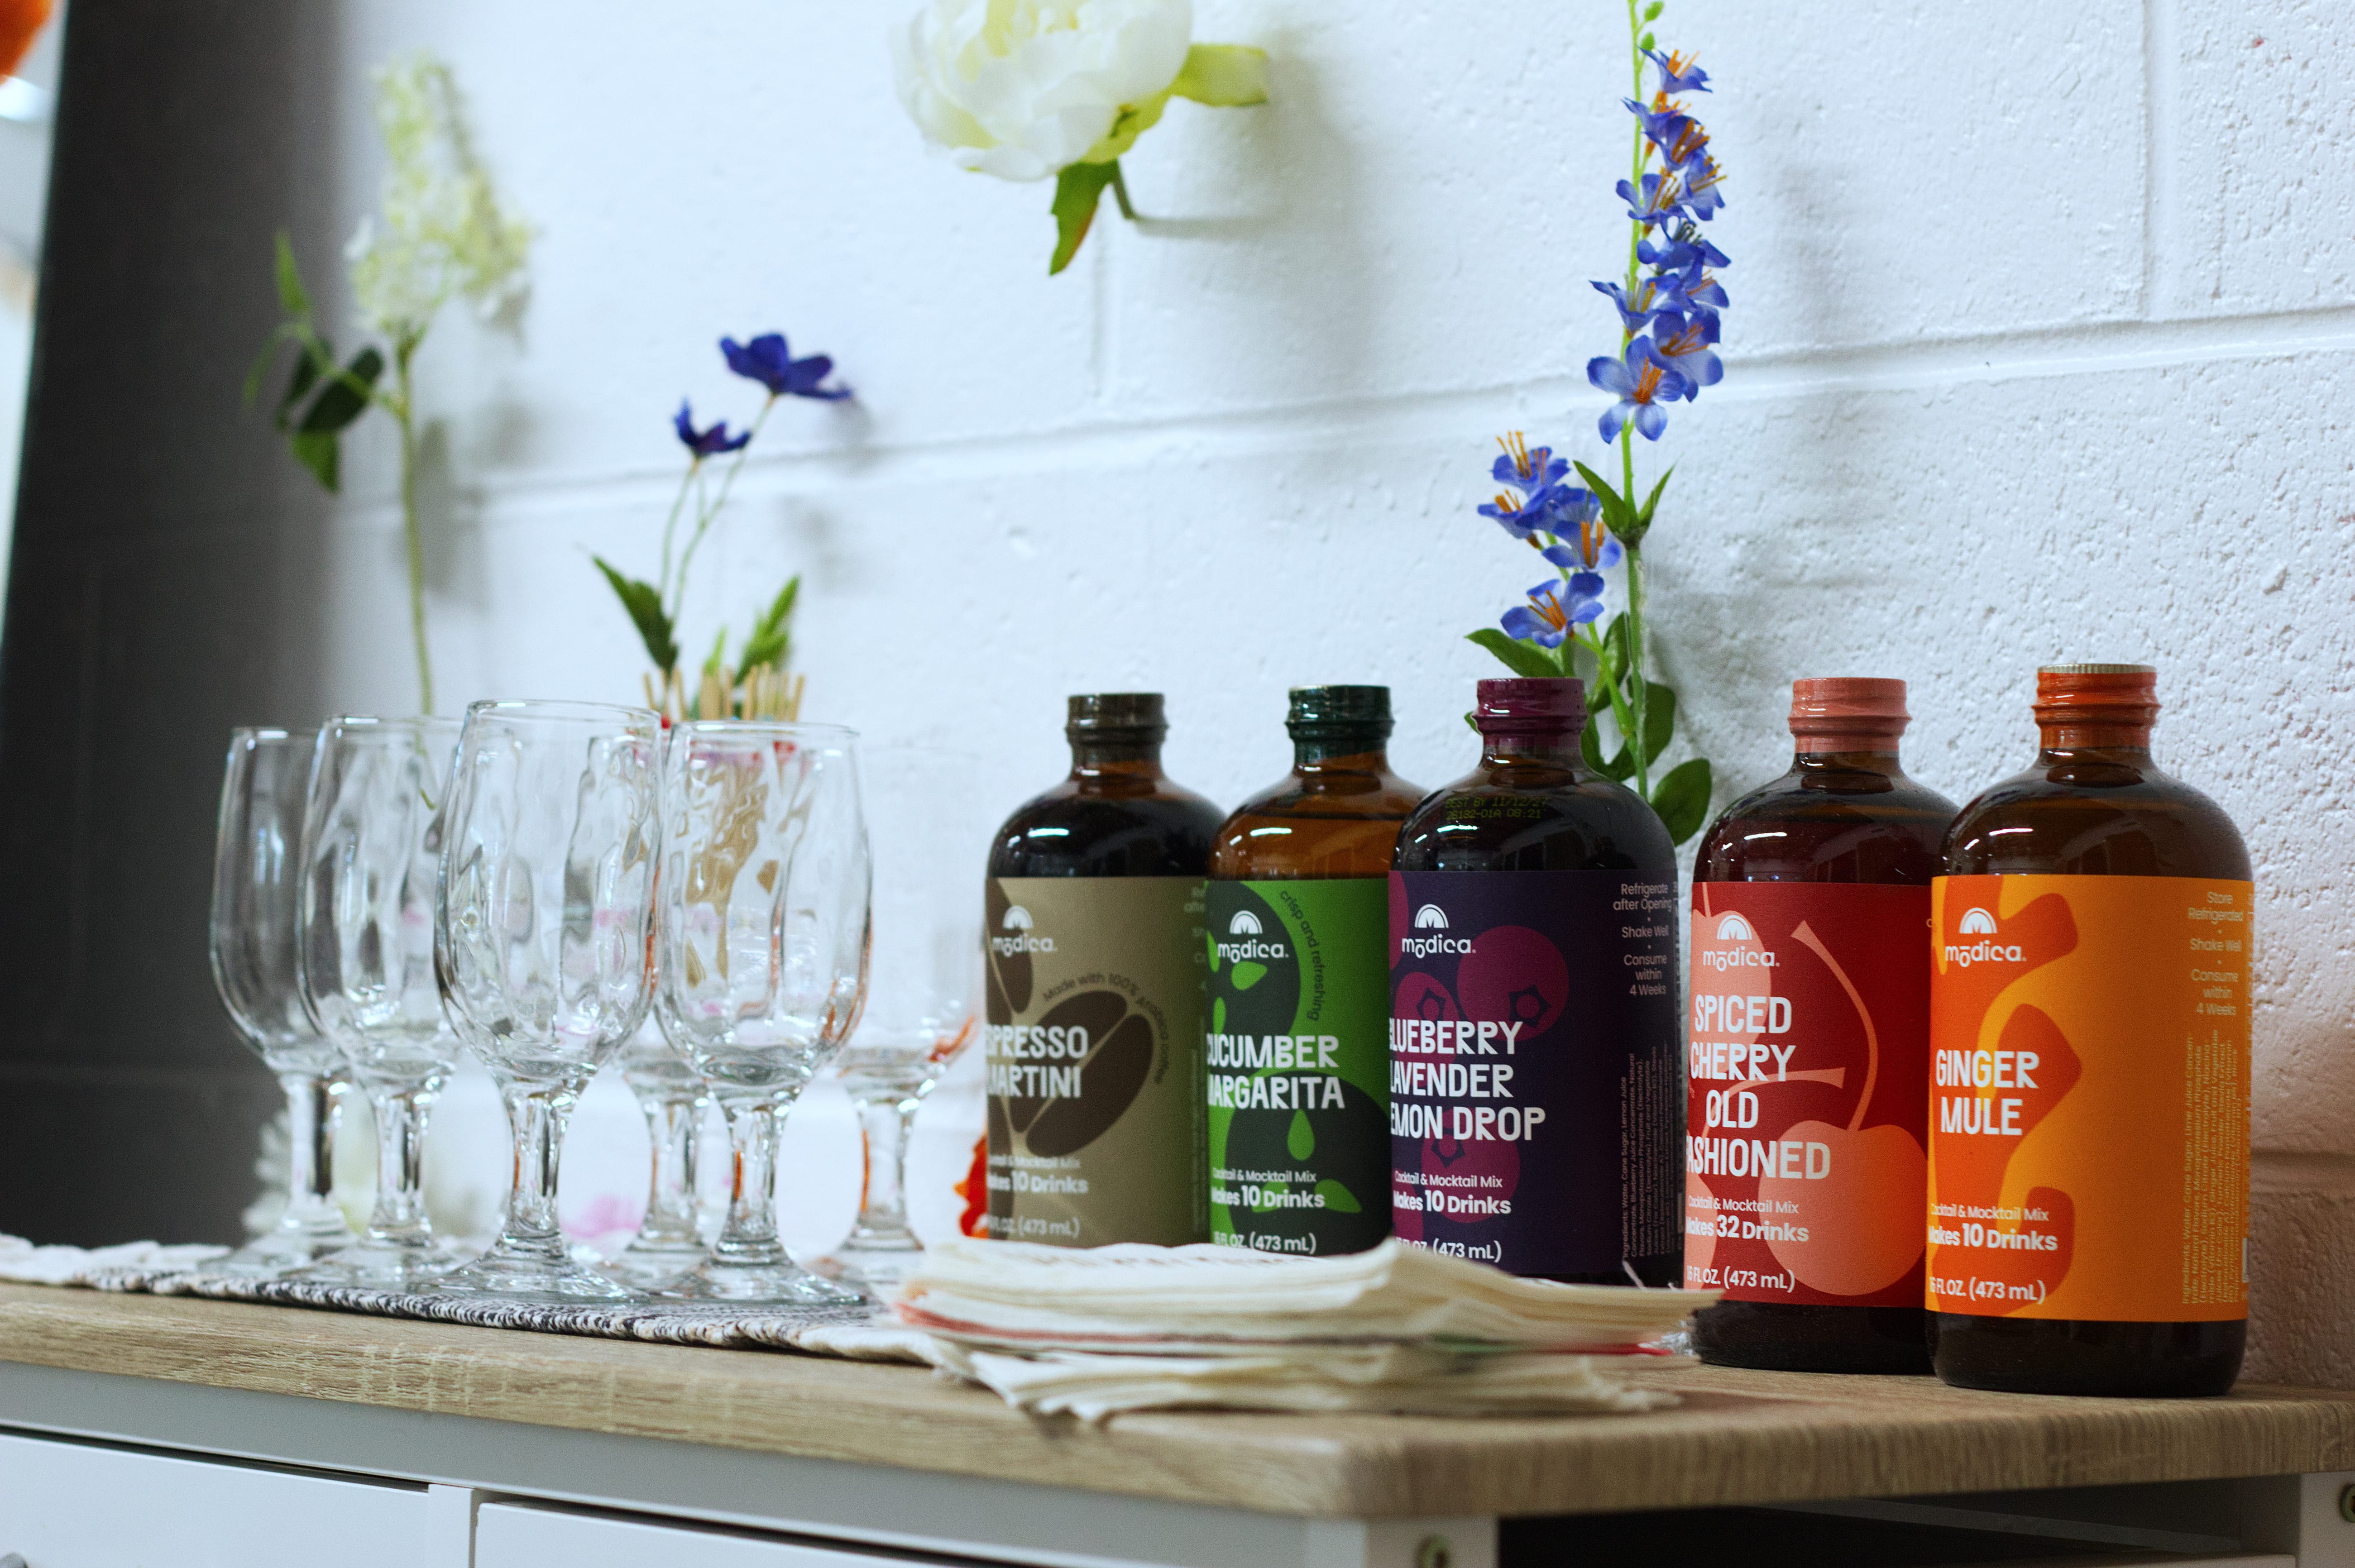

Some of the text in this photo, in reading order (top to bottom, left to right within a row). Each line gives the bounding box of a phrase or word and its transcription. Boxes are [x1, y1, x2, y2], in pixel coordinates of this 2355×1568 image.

[1621, 883, 1668, 898] Refrigerate
[2207, 891, 2233, 904] Store
[1613, 897, 1671, 913] after Opening
[1622, 925, 1670, 937] Shake Well
[1280, 890, 1326, 1021] crisp and refreshing
[2190, 938, 2224, 951] Shake
[1623, 954, 1667, 965] Consume
[1636, 968, 1662, 980] within
[2192, 969, 2238, 982] Consume
[1630, 984, 1666, 996] 4 Weeks
[2203, 985, 2232, 999] within
[1694, 994, 1792, 1033] SPICED
[2197, 1002, 2236, 1015] 4 Weeks
[1690, 1041, 1796, 1082] CHERRY
[1936, 1049, 2039, 1089] GINGER
[1706, 1090, 1759, 1128] OLD
[1941, 1096, 2023, 1135] MULE
[1453, 1106, 1546, 1141] DROP
[1011, 1171, 1028, 1192] 10
[1030, 1175, 1089, 1194] Drinks
[1237, 1170, 1245, 1181] &
[1246, 1171, 1292, 1182] Mocktail
[1295, 1171, 1316, 1182] Mix
[1420, 1173, 1428, 1186] &
[1429, 1174, 1477, 1187] Mocktail
[1480, 1176, 1503, 1188] Mix
[1241, 1185, 1261, 1207] 10
[1264, 1189, 1325, 1207] Drinks
[1393, 1190, 1512, 1214] Makes 10 Drinks
[1714, 1198, 1721, 1209] &
[1723, 1199, 1772, 1213] Mocktail
[1776, 1201, 1799, 1214] Mix
[1958, 1205, 1966, 1218] &
[1967, 1205, 2021, 1220] Mocktail
[2024, 1208, 2049, 1221] Mix
[1716, 1214, 1740, 1238] 32
[1742, 1220, 1809, 1242] Drinks
[1962, 1223, 1984, 1247] 10
[1987, 1228, 2058, 1251] Drinks
[1250, 1231, 1281, 1251] (473
[1284, 1233, 1316, 1255] mL)
[1433, 1238, 1465, 1258] (473
[1469, 1240, 1501, 1263] mL)
[1703, 1268, 1721, 1284] OZ.
[1724, 1266, 1757, 1289] (473
[1761, 1269, 1795, 1293] mL)
[1947, 1279, 1966, 1296] OZ.
[1970, 1276, 2005, 1301] (473
[2009, 1280, 2045, 1305] mL)
